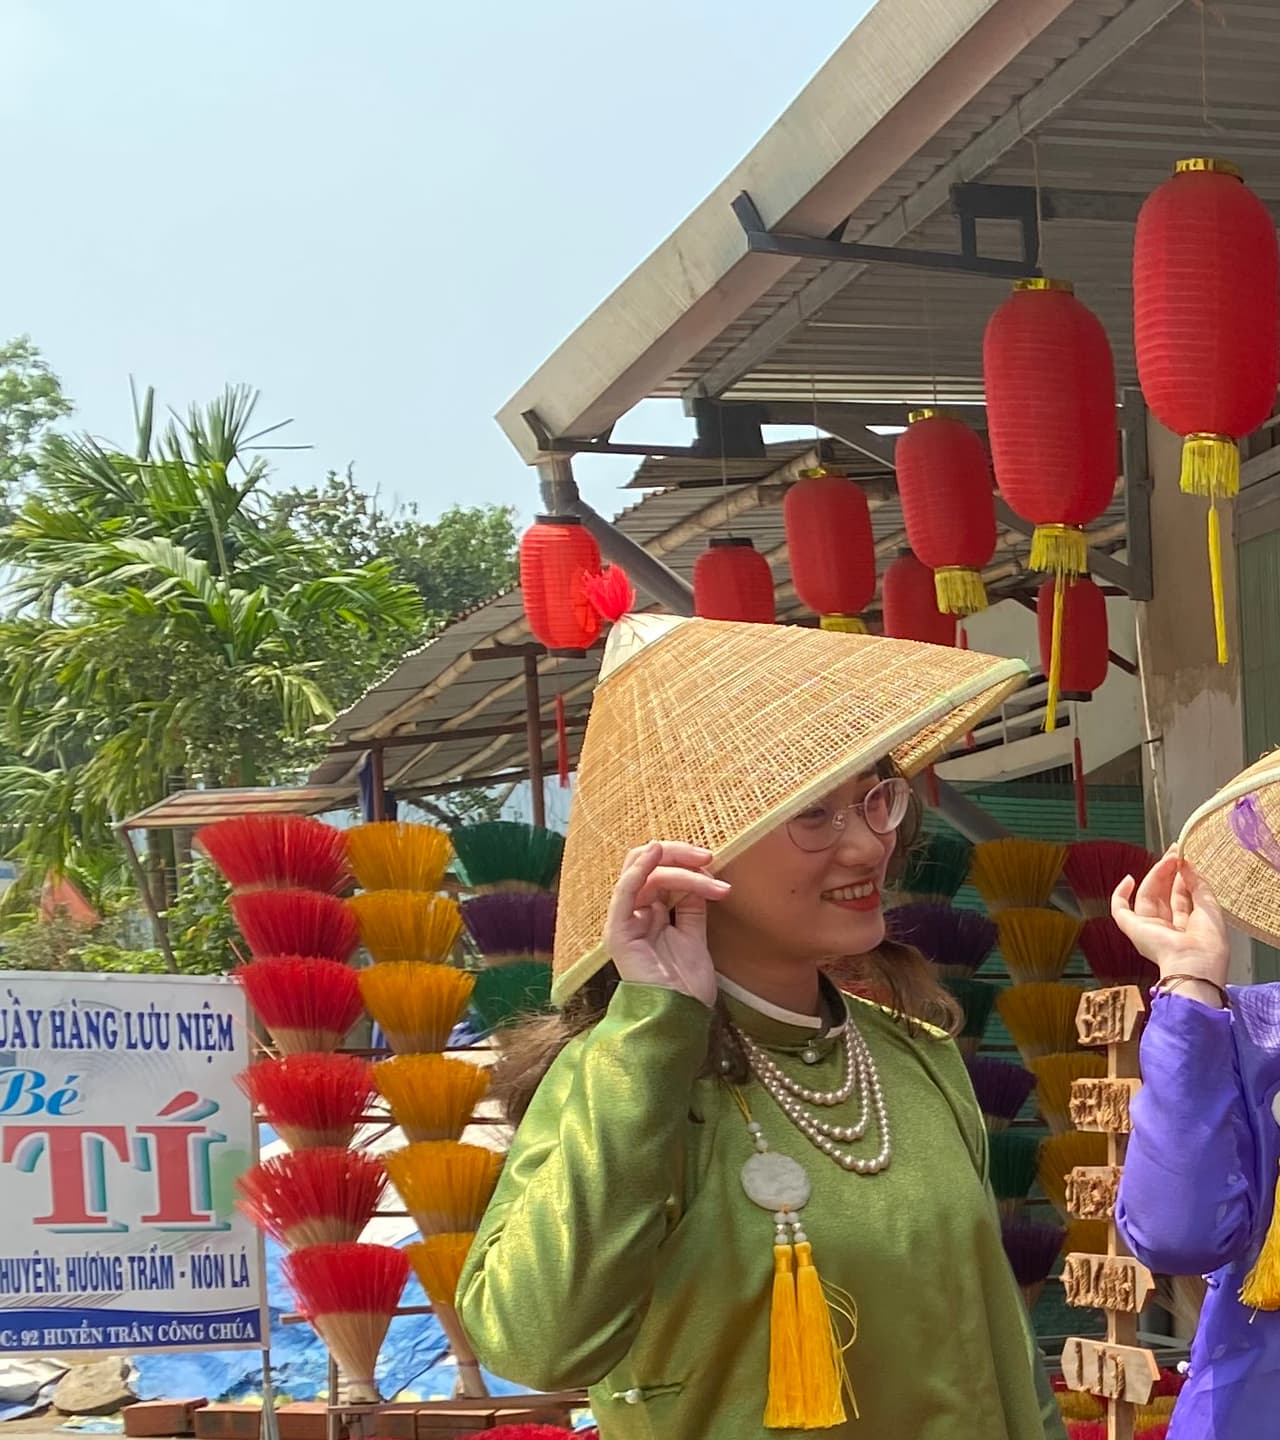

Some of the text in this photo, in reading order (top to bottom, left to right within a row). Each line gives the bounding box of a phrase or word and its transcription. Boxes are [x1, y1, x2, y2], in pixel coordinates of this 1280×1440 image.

[49, 998, 118, 1049] HÀNG
[124, 1002, 170, 1050] LƯU
[176, 1001, 234, 1064] NIỆM
[0, 1068, 83, 1116] Bé
[2, 1090, 222, 1228] TÍ
[66, 1250, 123, 1292] HƯƠNG
[190, 1246, 225, 1289] NÓN
[230, 1245, 250, 1288] LÁ
[21, 1330, 39, 1346] 92
[106, 1321, 153, 1343] TRÂN
[158, 1320, 205, 1342] CÔNG
[208, 1317, 255, 1340] CHÚA
